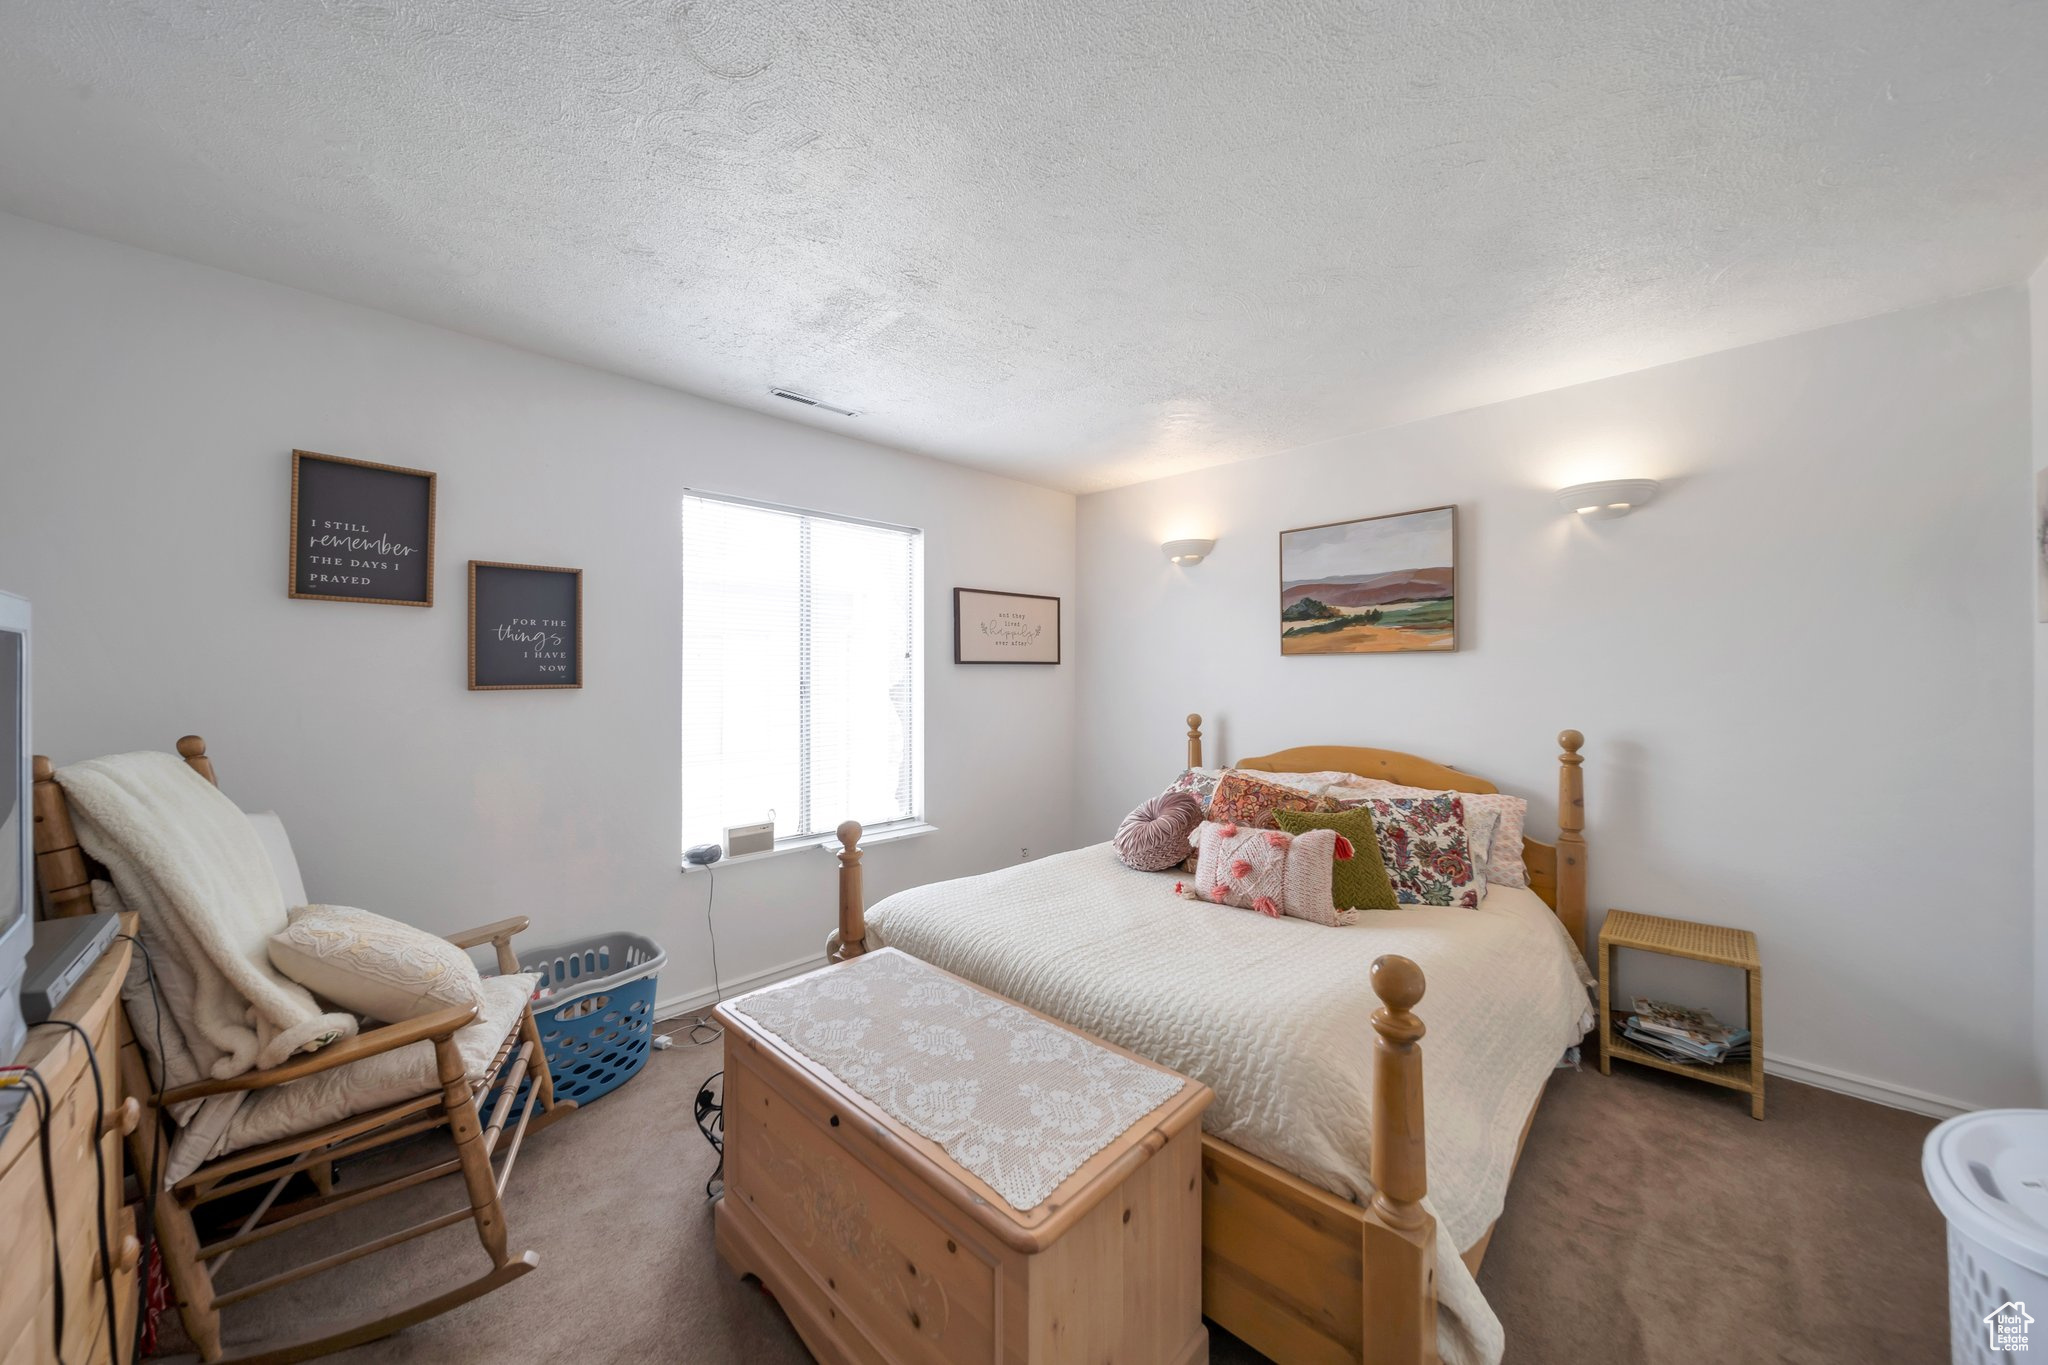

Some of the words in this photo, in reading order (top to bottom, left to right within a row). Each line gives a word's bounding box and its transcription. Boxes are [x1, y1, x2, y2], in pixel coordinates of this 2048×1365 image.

[311, 519, 317, 527] I
[324, 520, 370, 533] STILL
[310, 534, 418, 556] remember
[310, 555, 343, 567] THE
[351, 559, 388, 570] DAYS
[394, 563, 399, 571] I
[310, 574, 371, 585] PRAYED
[513, 618, 537, 627] FOR
[542, 619, 567, 627] THE
[489, 624, 565, 650] things
[989, 619, 1034, 645] happily
[534, 651, 567, 659] HAVE
[539, 664, 567, 673] NOW
